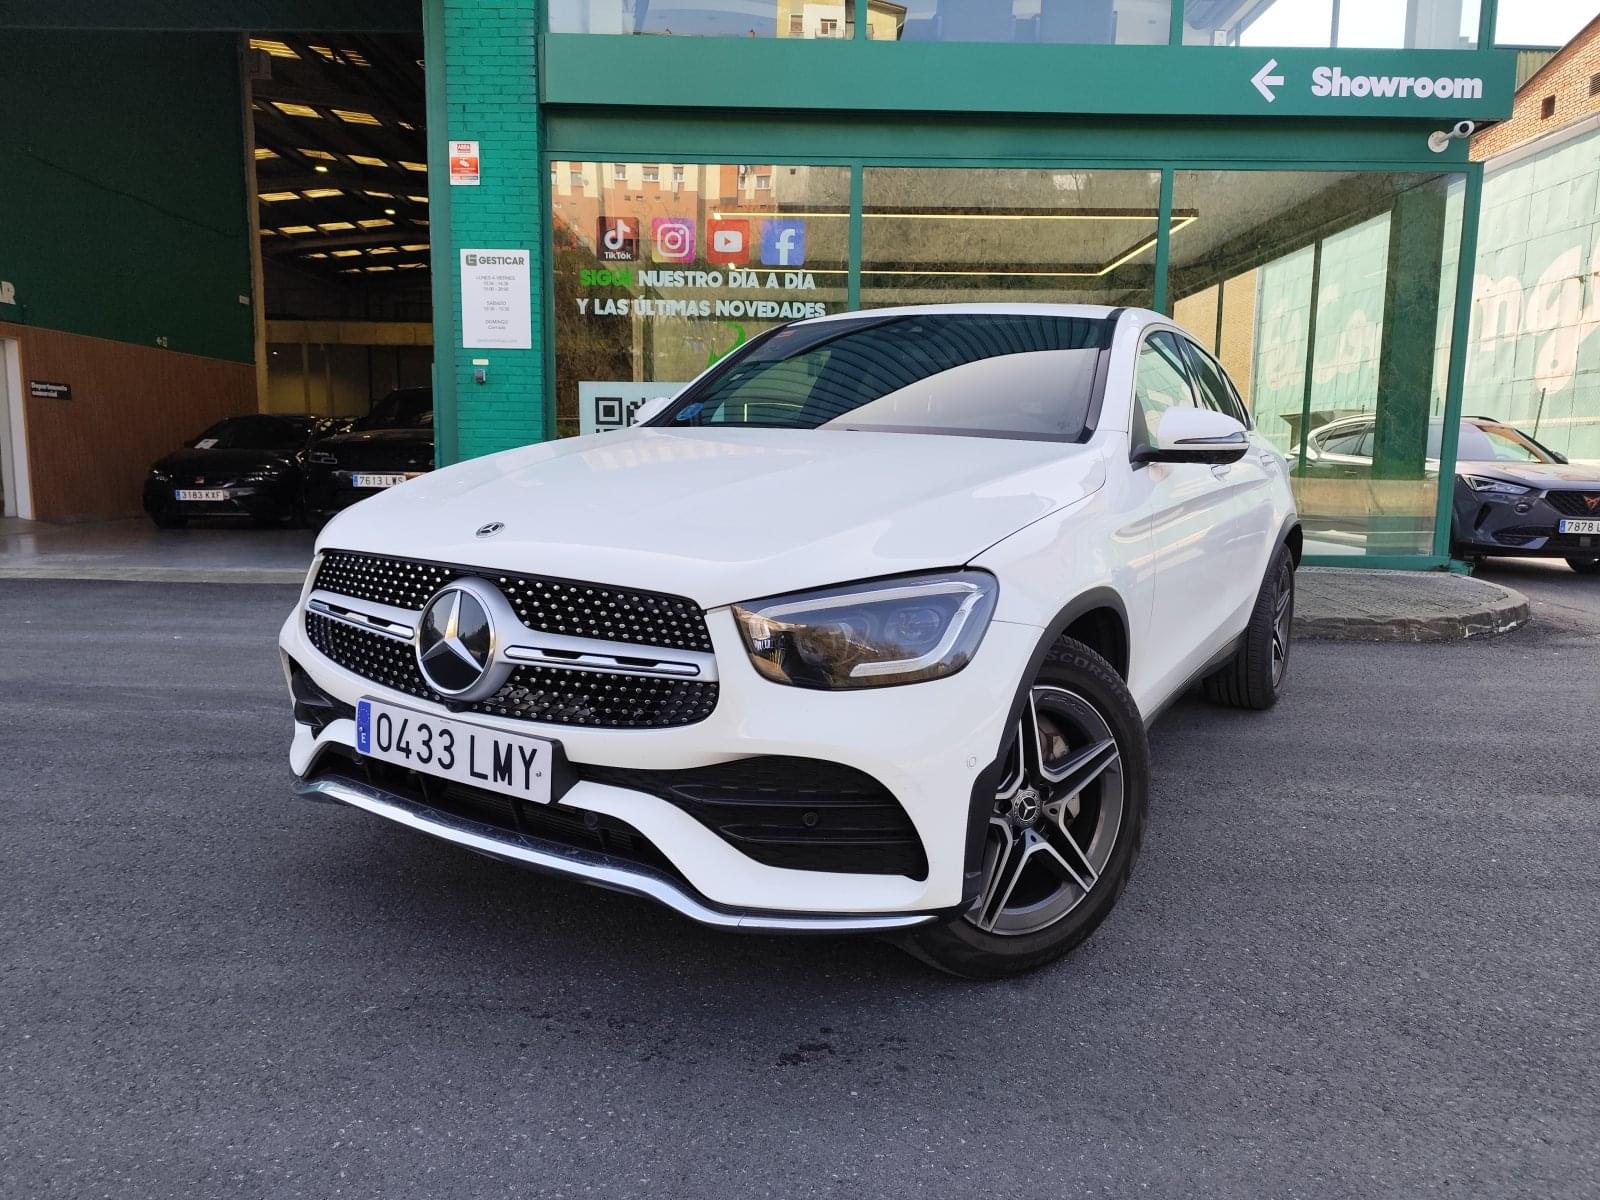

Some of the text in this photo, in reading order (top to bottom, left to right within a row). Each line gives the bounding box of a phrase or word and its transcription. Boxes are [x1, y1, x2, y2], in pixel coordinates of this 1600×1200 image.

[1311, 66, 1483, 99] Showroom
[479, 256, 525, 266] GESTICAR
[605, 251, 632, 260] TikTok
[638, 270, 723, 288] NUESTRO
[728, 267, 760, 289] DÍA
[765, 272, 779, 289] A
[784, 269, 816, 290] DÍA
[575, 295, 826, 319] Y LAS ÚLTIMAS NOVEDADES
[359, 476, 382, 486] 7613
[1567, 521, 1594, 532] 7878
[376, 712, 538, 791] 0433 LMY
